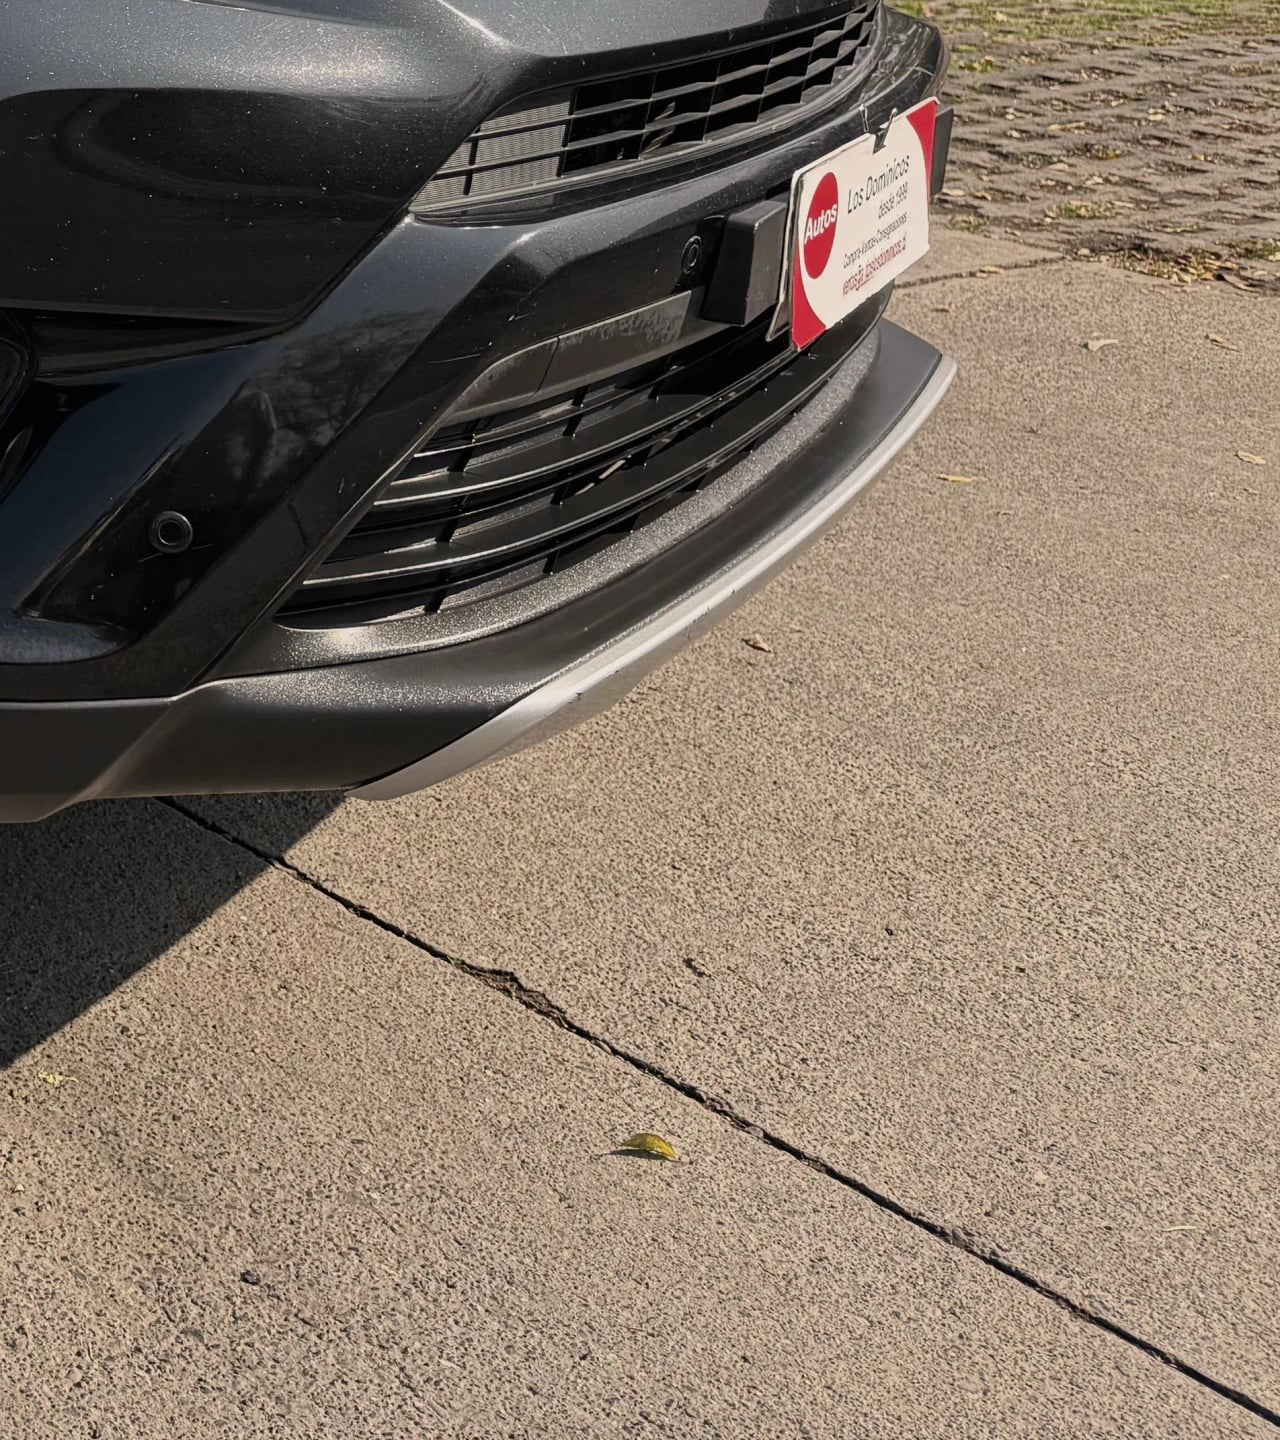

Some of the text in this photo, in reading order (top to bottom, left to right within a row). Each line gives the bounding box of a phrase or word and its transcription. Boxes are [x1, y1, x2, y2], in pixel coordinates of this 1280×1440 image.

[847, 155, 909, 214] Los Dominicos
[804, 204, 838, 244] Autos
